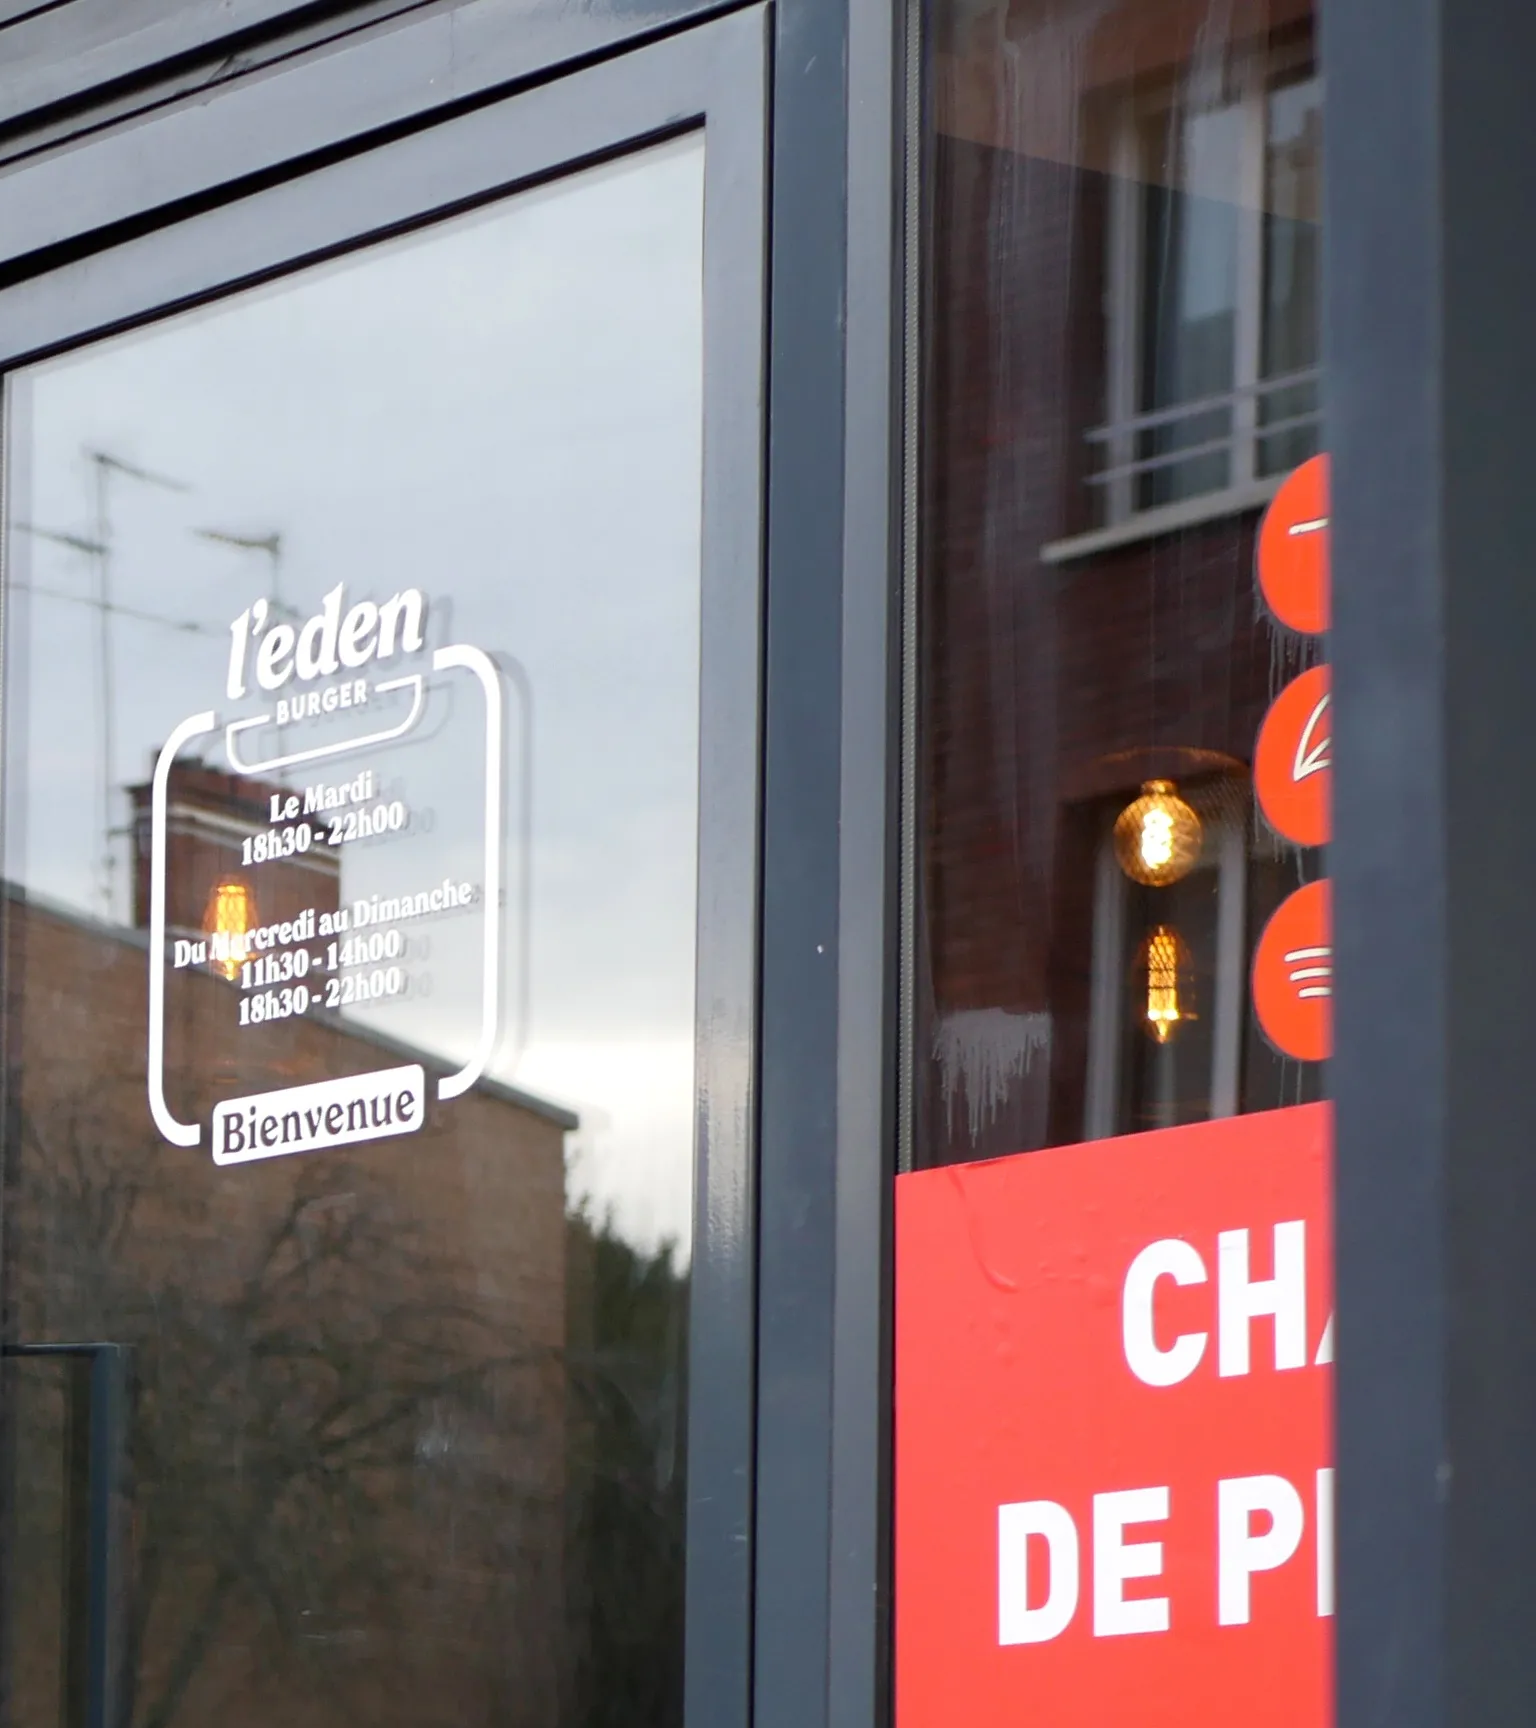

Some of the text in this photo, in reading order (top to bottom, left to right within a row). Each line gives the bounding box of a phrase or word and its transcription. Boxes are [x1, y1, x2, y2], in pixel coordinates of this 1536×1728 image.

[226, 581, 423, 700] l'eden
[276, 679, 368, 725] BURGER
[270, 770, 373, 823] Le Mardi
[241, 823, 311, 866] 18h30
[328, 801, 404, 846] 22h00
[174, 939, 206, 968] Du
[319, 908, 348, 936] au
[353, 878, 472, 929] Dimanche
[241, 948, 309, 989] 11h30
[327, 929, 400, 971] 14h00
[239, 985, 309, 1026] 18h30
[325, 966, 400, 1008] 22h00
[221, 1089, 415, 1154] Bienvenue
[1122, 1219, 1336, 1387] CH
[998, 1468, 1336, 1646] DE P
